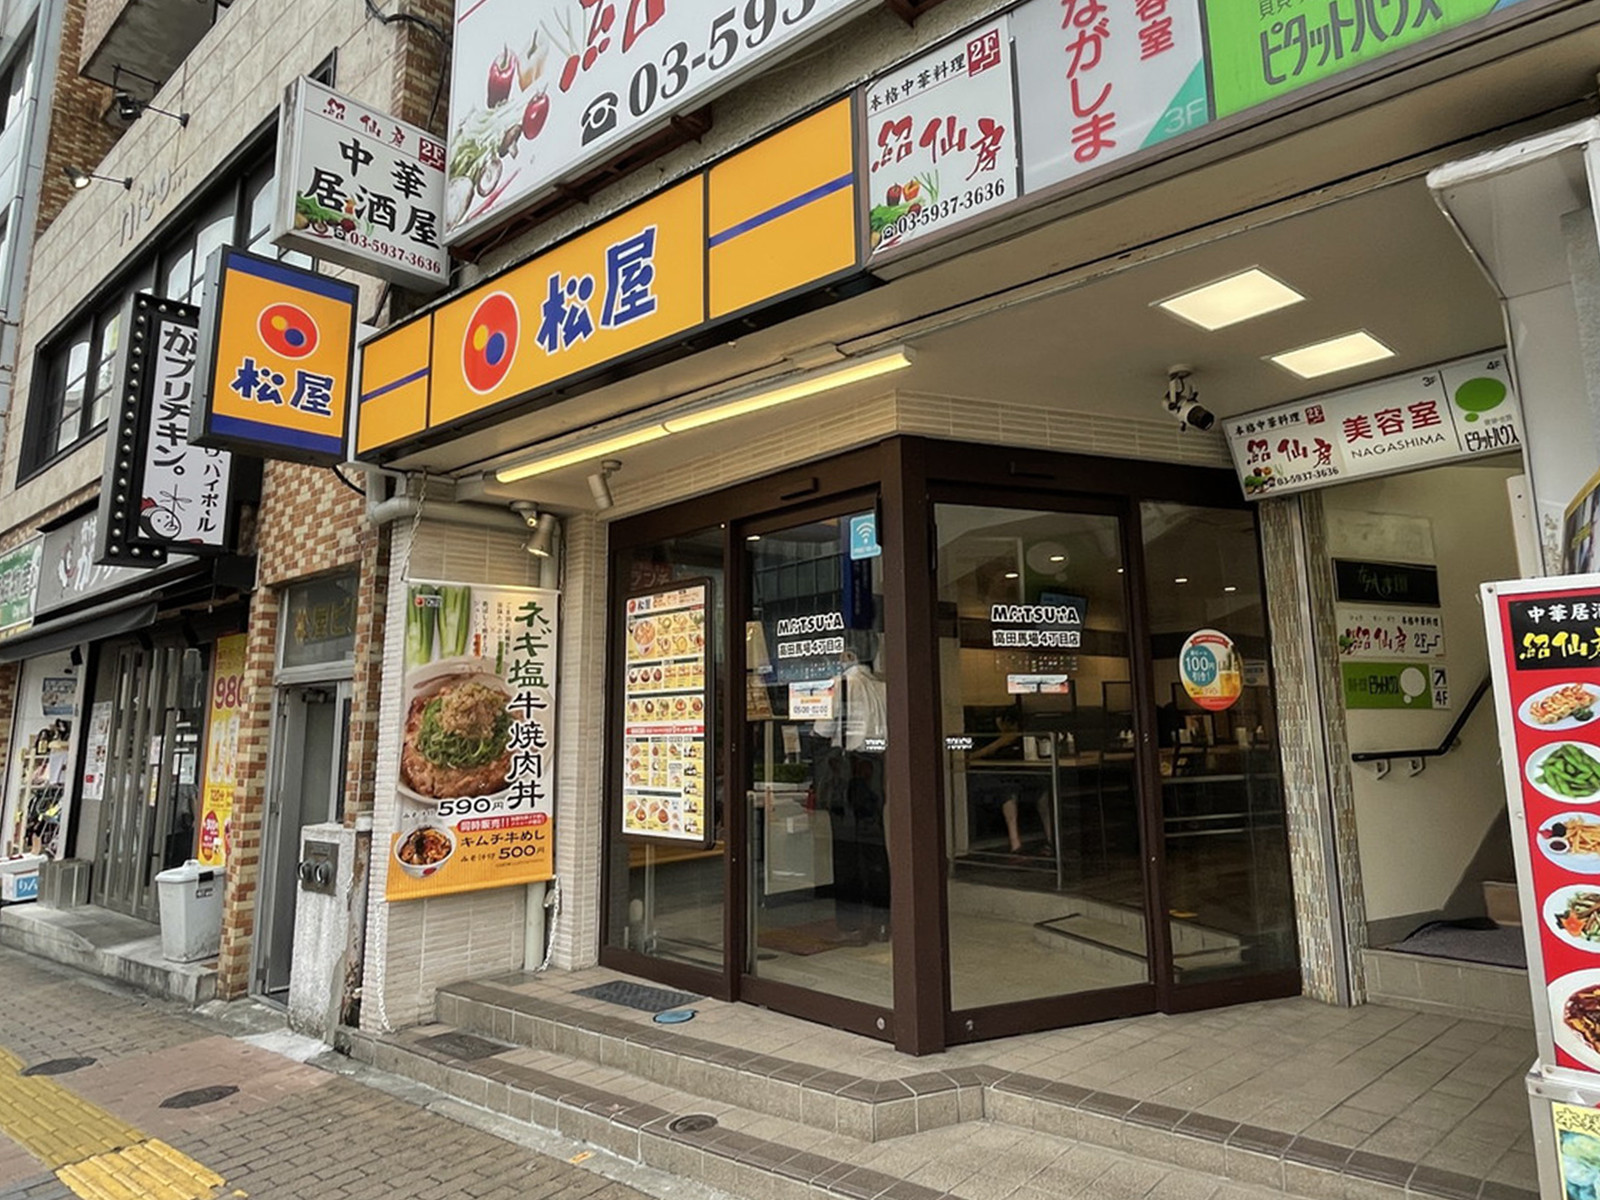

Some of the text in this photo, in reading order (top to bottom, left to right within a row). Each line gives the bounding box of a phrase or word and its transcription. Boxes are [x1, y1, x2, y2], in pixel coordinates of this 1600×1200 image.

[869, 33, 997, 112] 本格中華料理 2F
[1164, 97, 1204, 134] 3F
[338, 136, 427, 200] 中華
[421, 140, 445, 161] 2F
[303, 166, 440, 250] 居酒屋
[899, 178, 1006, 236] 03-5937-3636
[349, 231, 441, 275] 03-5937-3636
[534, 225, 658, 355] 松屋
[230, 357, 336, 418] 松屋
[1342, 400, 1442, 443] 美容室
[1351, 433, 1446, 459] NAGASHIMA
[1277, 466, 1340, 486] 03-5937-3636
[992, 629, 1080, 647] 高田馬場4丁目店
[507, 601, 552, 811] ネギ塩牛焼肉丼
[461, 830, 545, 848] キムチ牛めし
